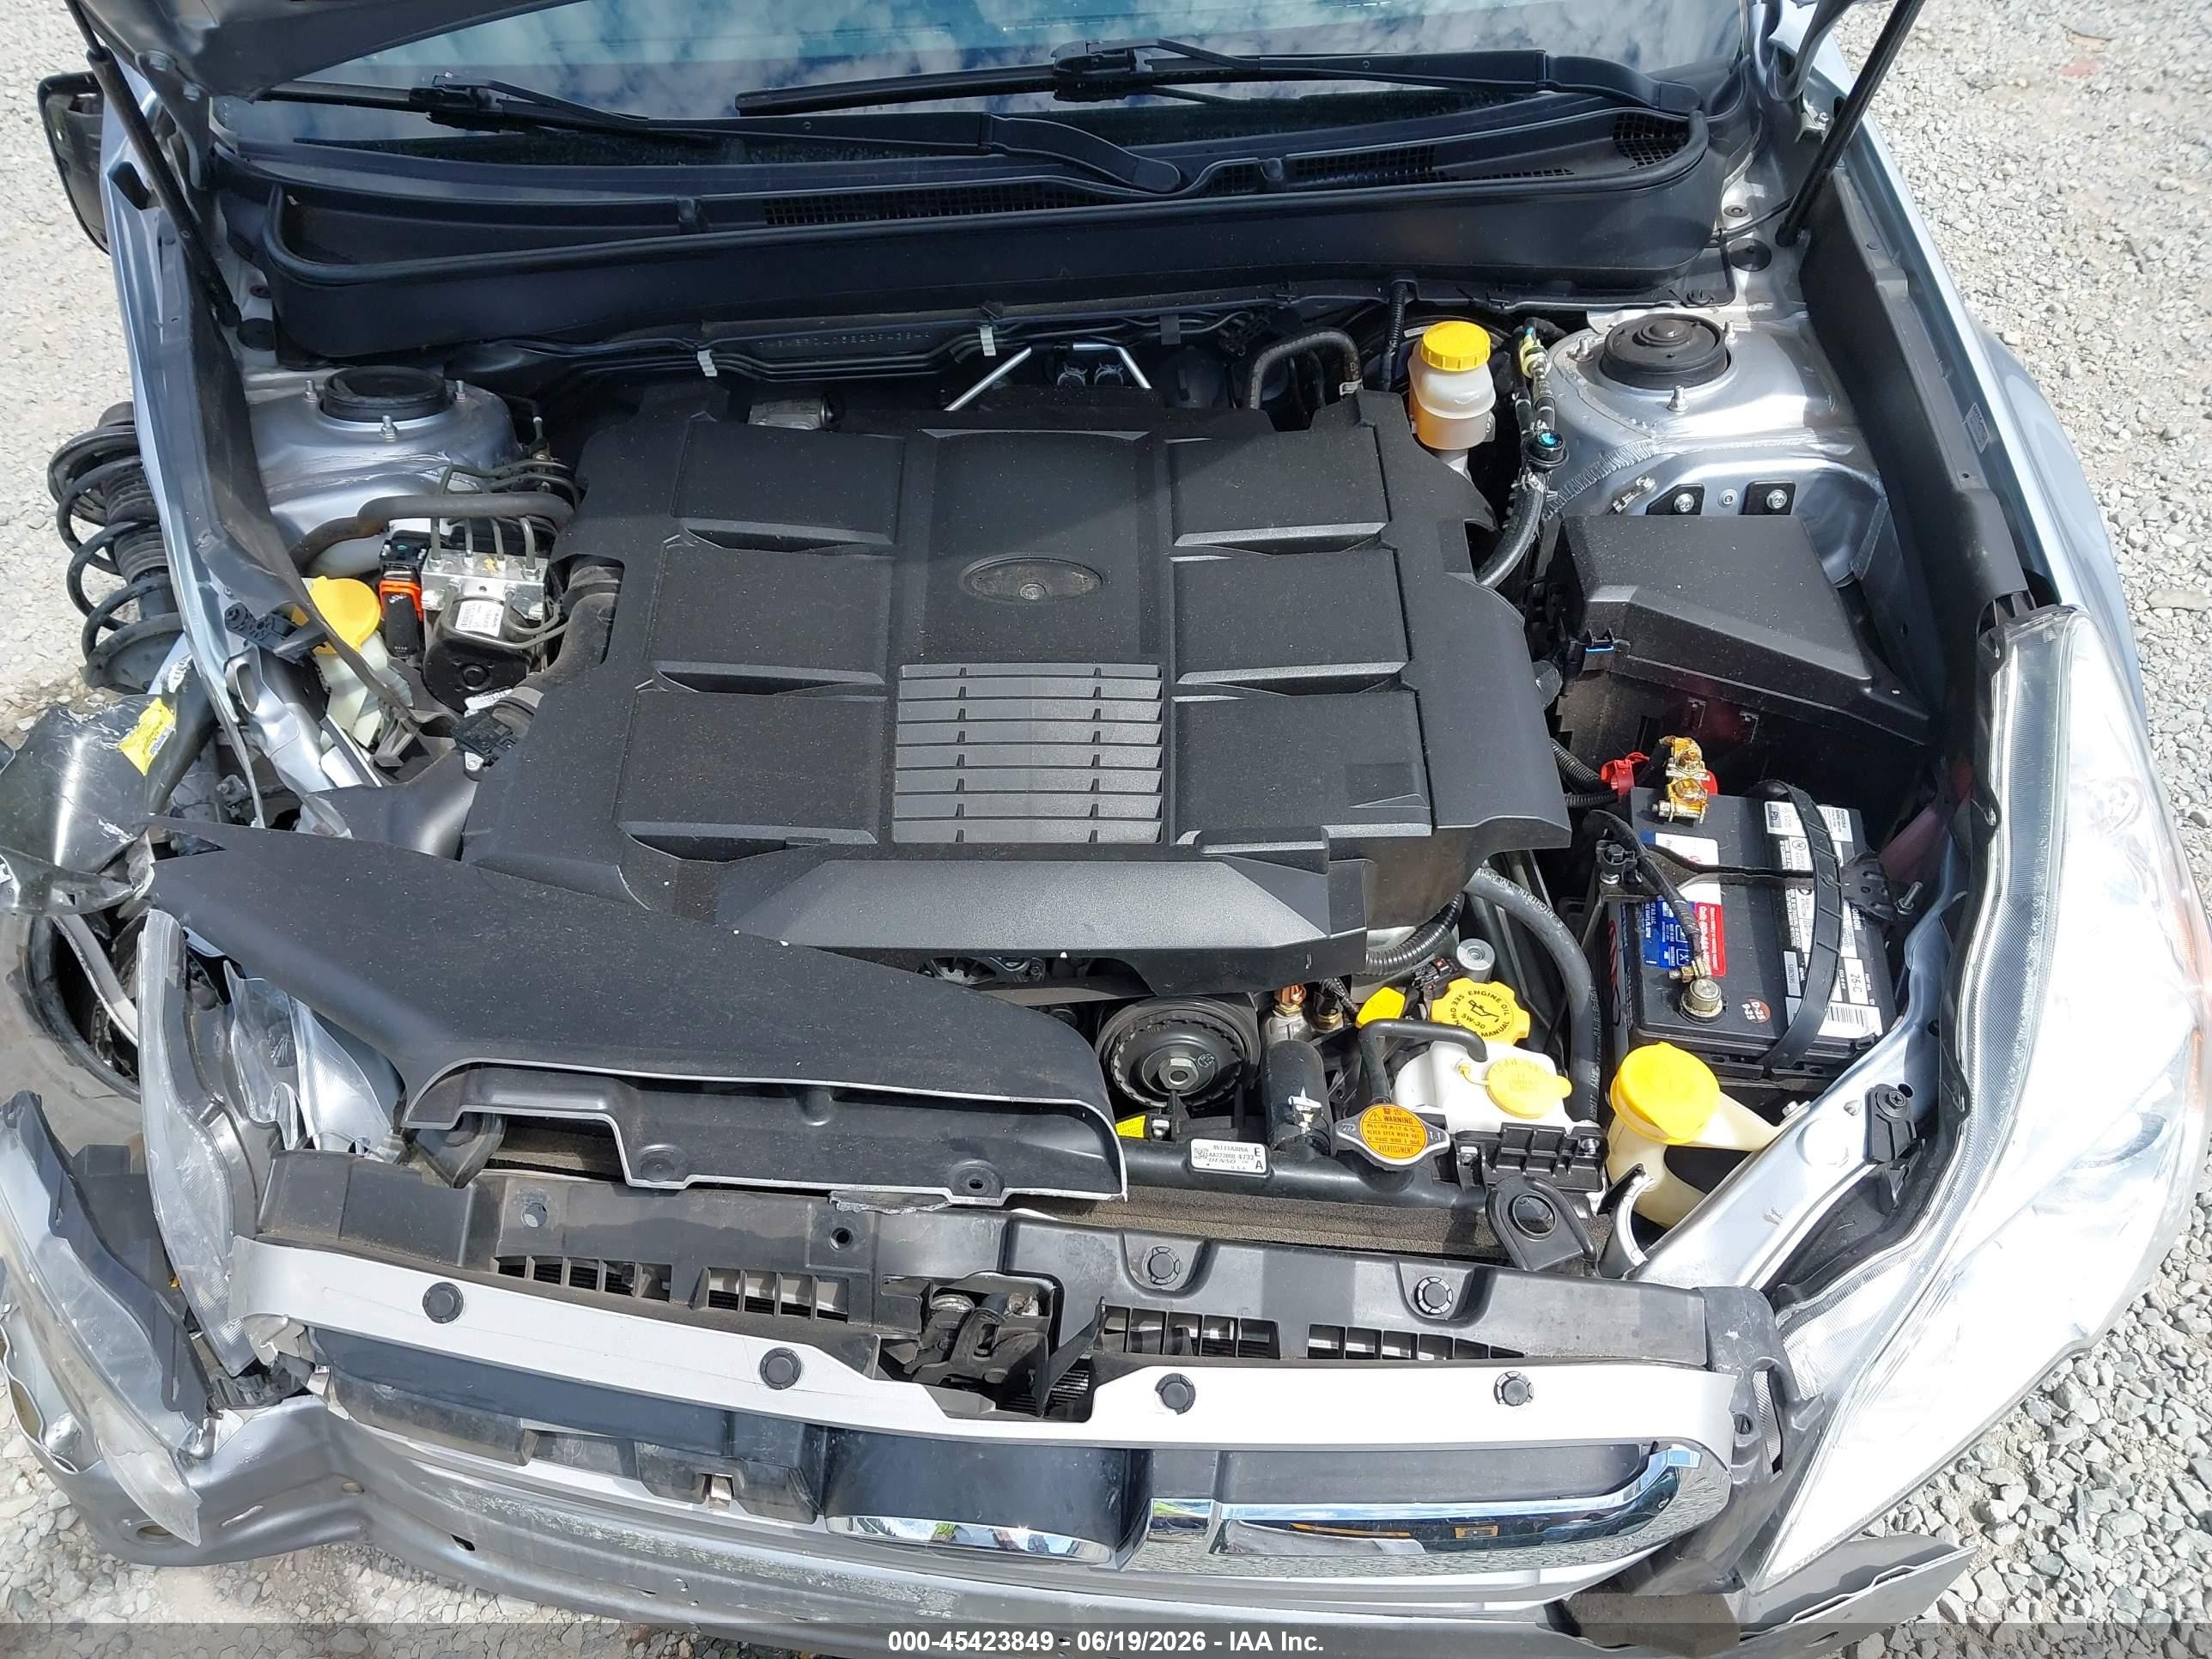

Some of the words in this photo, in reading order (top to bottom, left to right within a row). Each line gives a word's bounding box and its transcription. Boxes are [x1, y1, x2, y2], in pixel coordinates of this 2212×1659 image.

[1851, 906, 1862, 931] OISON
[1468, 990, 1503, 1003] ENGINE
[1501, 1004, 1510, 1016] OIL
[1451, 994, 1465, 1006] SEE
[1480, 1021, 1510, 1037] MANUAL
[1462, 1013, 1486, 1029] 5W-30
[1383, 1115, 1413, 1125] WARNING
[1254, 1147, 1262, 1157] E
[1255, 1160, 1264, 1170] A
